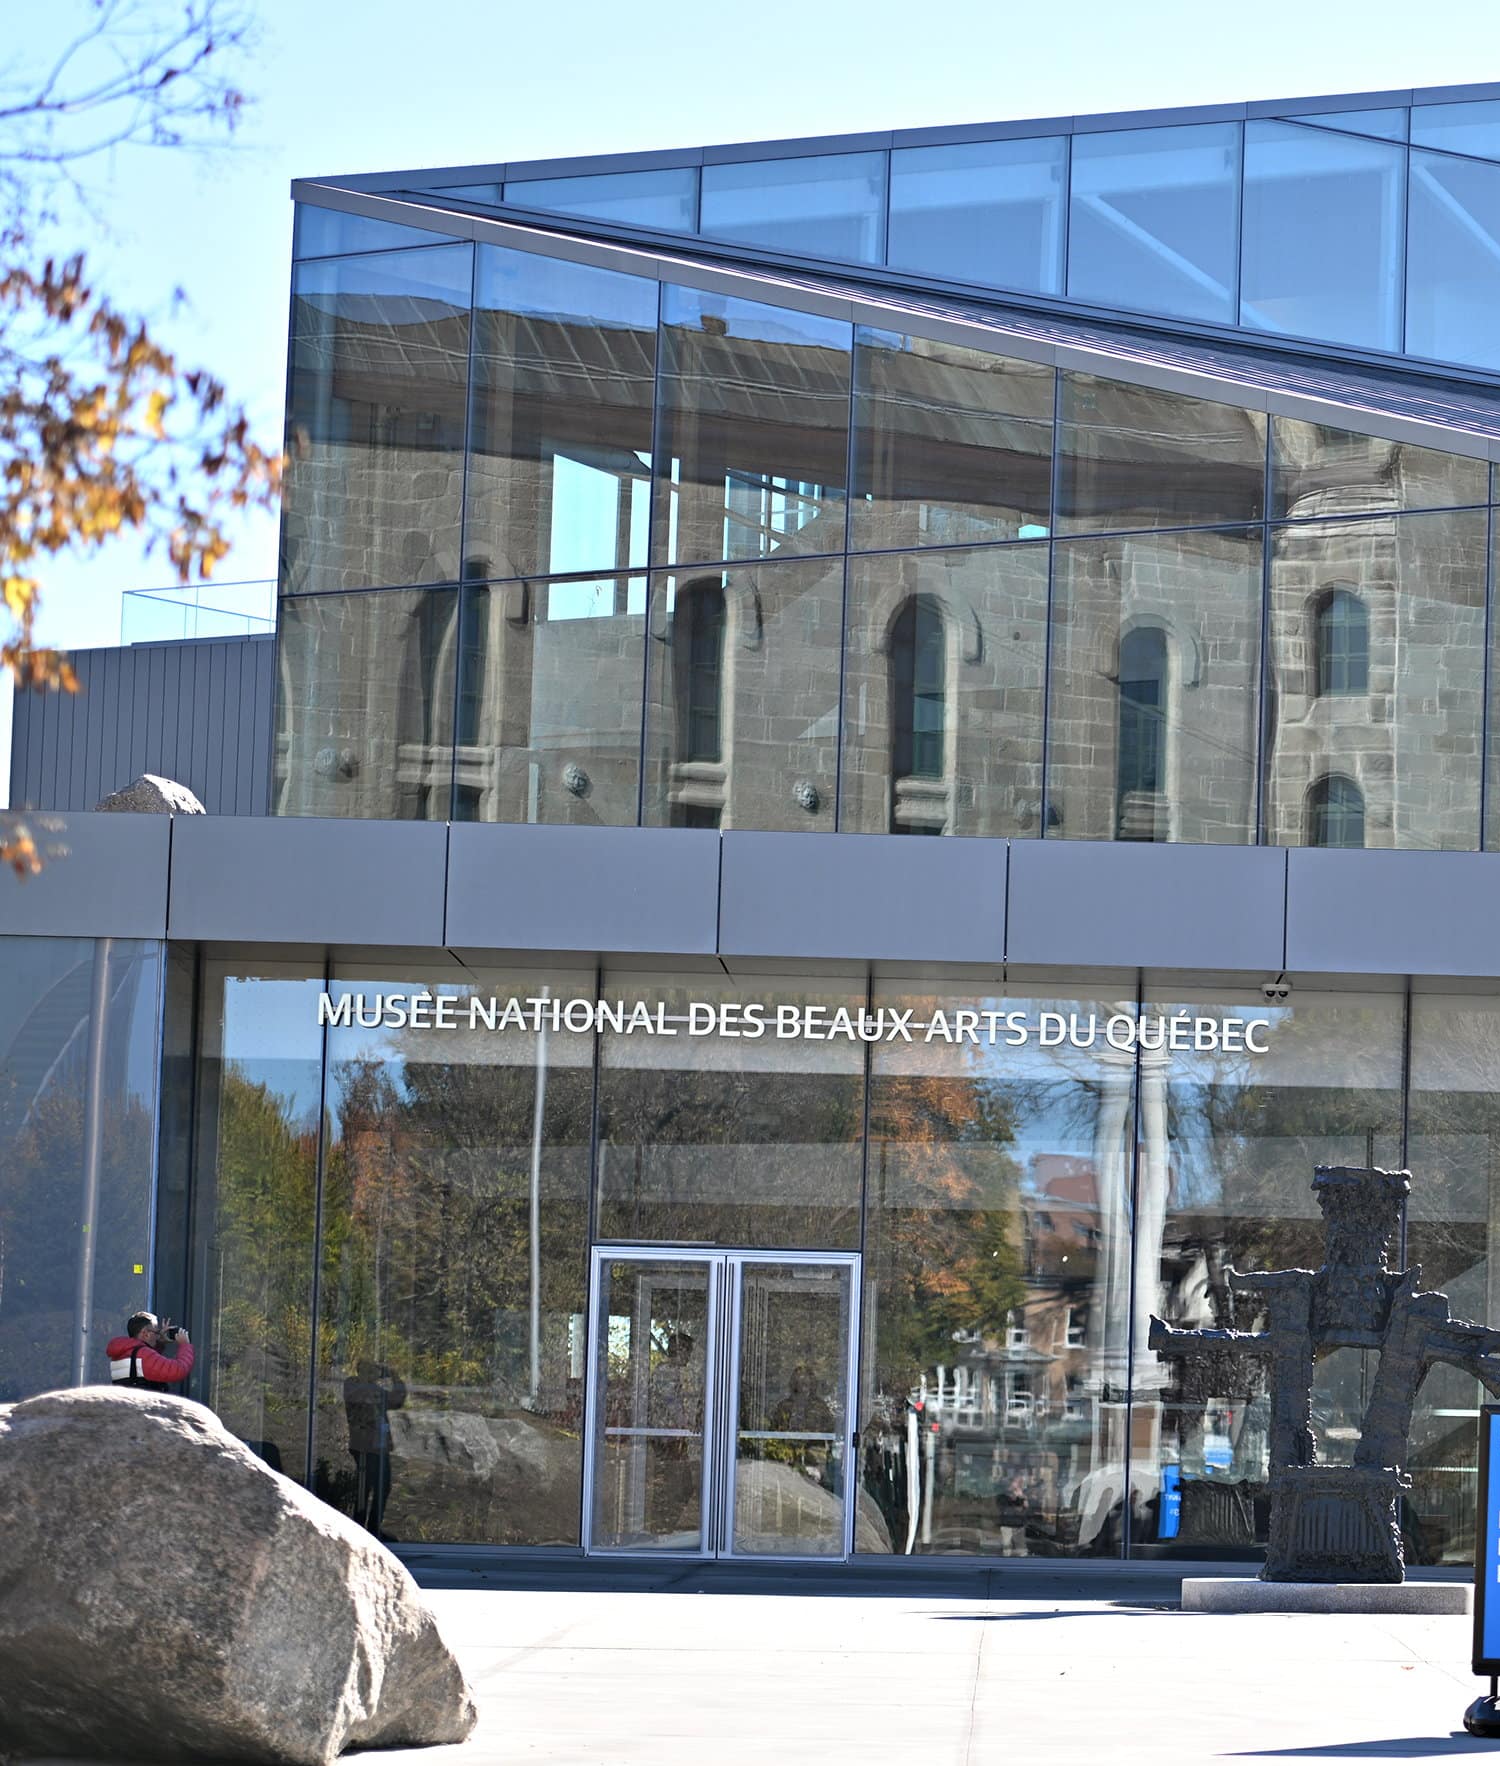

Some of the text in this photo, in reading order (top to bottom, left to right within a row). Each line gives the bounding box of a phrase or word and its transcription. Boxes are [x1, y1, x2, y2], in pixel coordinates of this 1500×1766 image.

[469, 996, 678, 1036] NATIONAL
[688, 1002, 765, 1038] DES
[776, 1004, 1029, 1047] BEAUX-ARTS
[1039, 1012, 1097, 1048] DU
[1106, 1009, 1270, 1054] QUÉBEC
